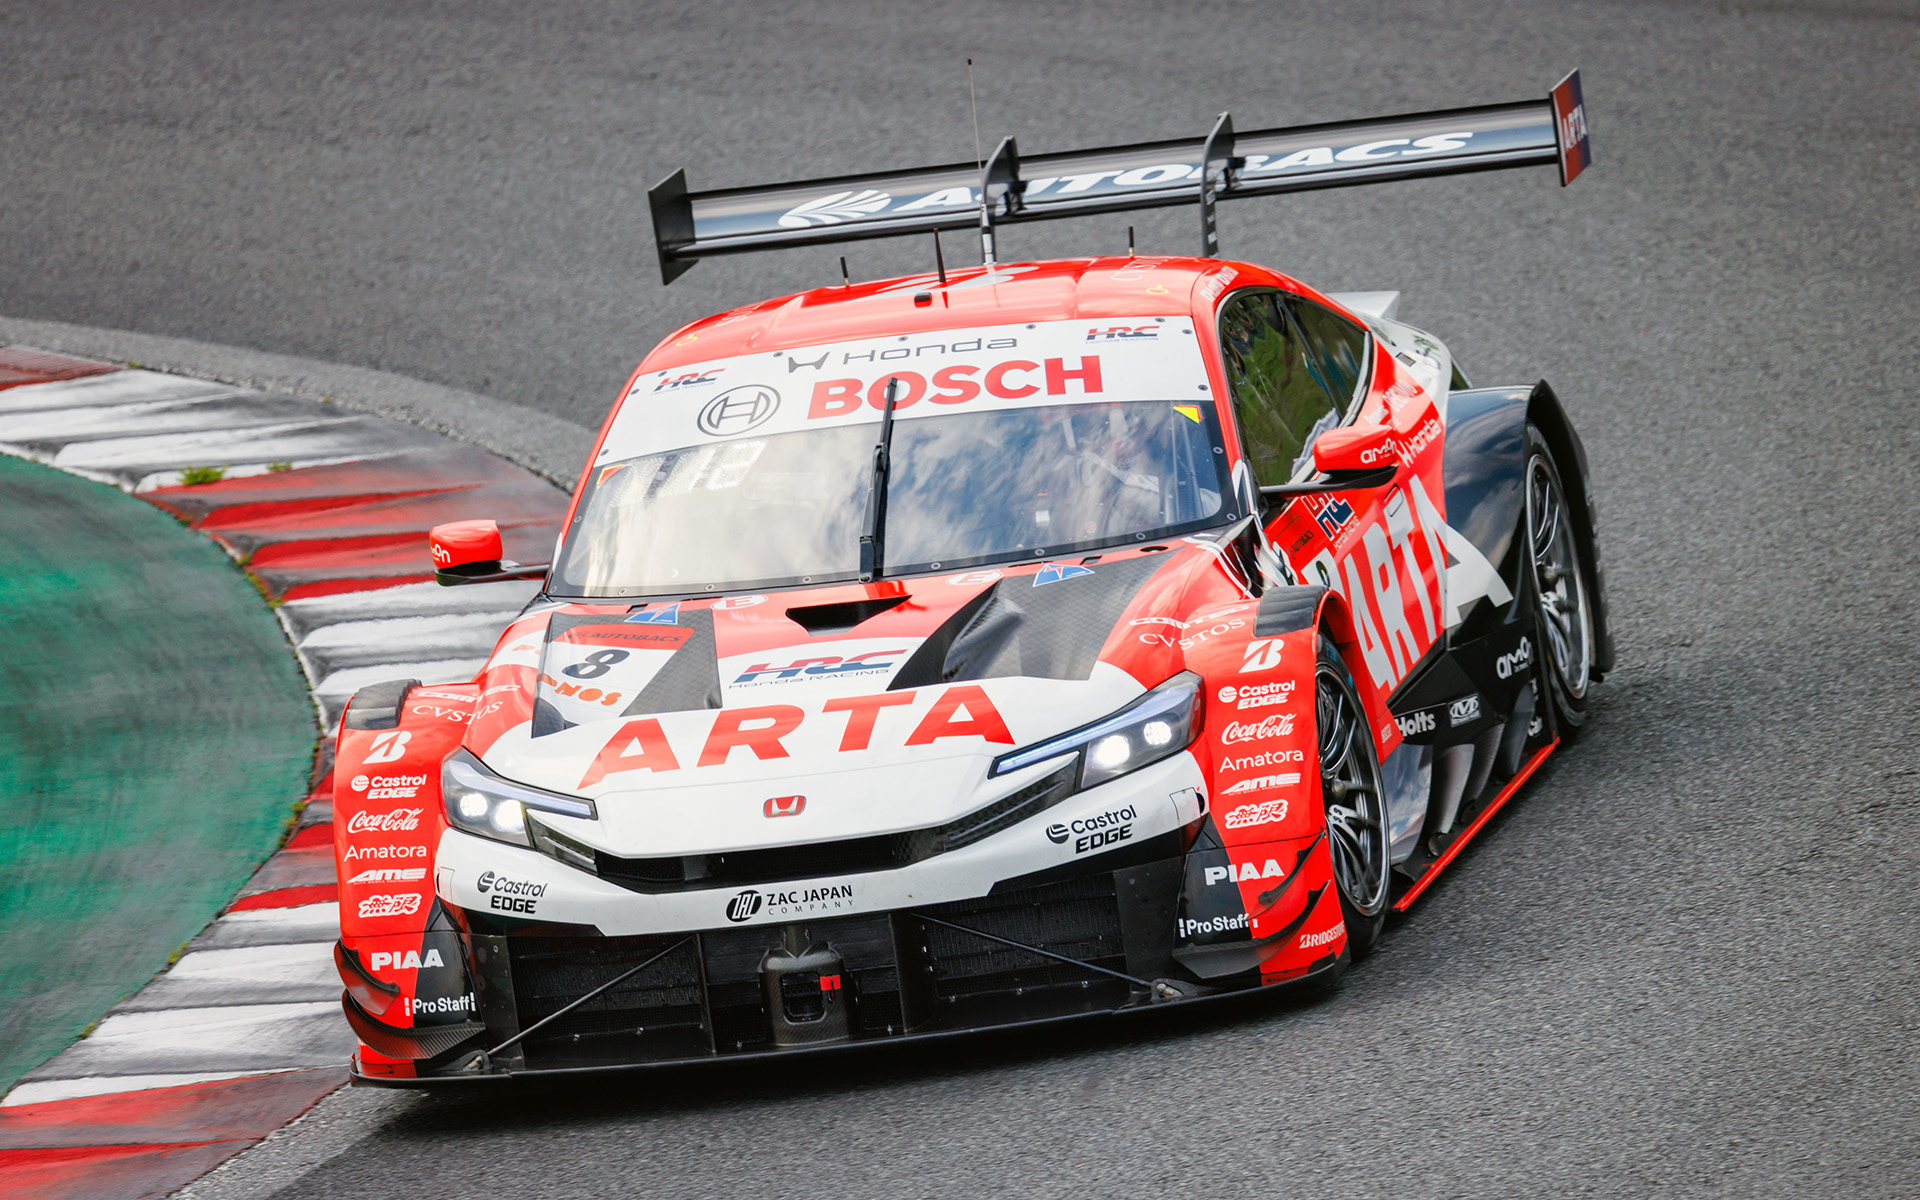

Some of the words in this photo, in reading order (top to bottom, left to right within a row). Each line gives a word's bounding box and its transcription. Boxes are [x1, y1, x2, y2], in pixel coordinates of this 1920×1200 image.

[1086, 326, 1160, 341] HRC
[842, 338, 1017, 365] Honda
[653, 368, 726, 393] HRC
[807, 355, 1103, 420] BOSCH
[1404, 419, 1442, 458] Honda
[1343, 474, 1514, 691] ARTA
[589, 631, 684, 643] AUTOBACS
[1139, 619, 1246, 651] CVSTOS
[561, 649, 630, 680] 8
[733, 649, 908, 684] HRC
[728, 677, 803, 689] Honda
[809, 669, 889, 681] RACING
[1238, 680, 1296, 698] Castrol
[1237, 692, 1289, 711] EDGE
[1221, 713, 1297, 745] Coca-Cola
[1394, 711, 1436, 737] Holts
[579, 685, 1016, 788] ARTA
[1219, 749, 1304, 773] Amatora
[366, 786, 419, 799] EDGE
[371, 774, 427, 787] Castrol
[1220, 772, 1301, 794] AME
[347, 808, 424, 834] Coca-Cola
[1070, 804, 1138, 834] Castrol
[1075, 822, 1133, 854] EDGE
[343, 844, 427, 862] Amatora
[347, 868, 427, 884] AME
[1204, 859, 1285, 886] PIAA
[493, 877, 549, 898] Castrol
[766, 891, 798, 906] ZAC
[802, 885, 853, 902] JAPAN
[490, 895, 537, 915] EDGE
[768, 899, 854, 916] COMPANY
[371, 948, 445, 971] PIAA
